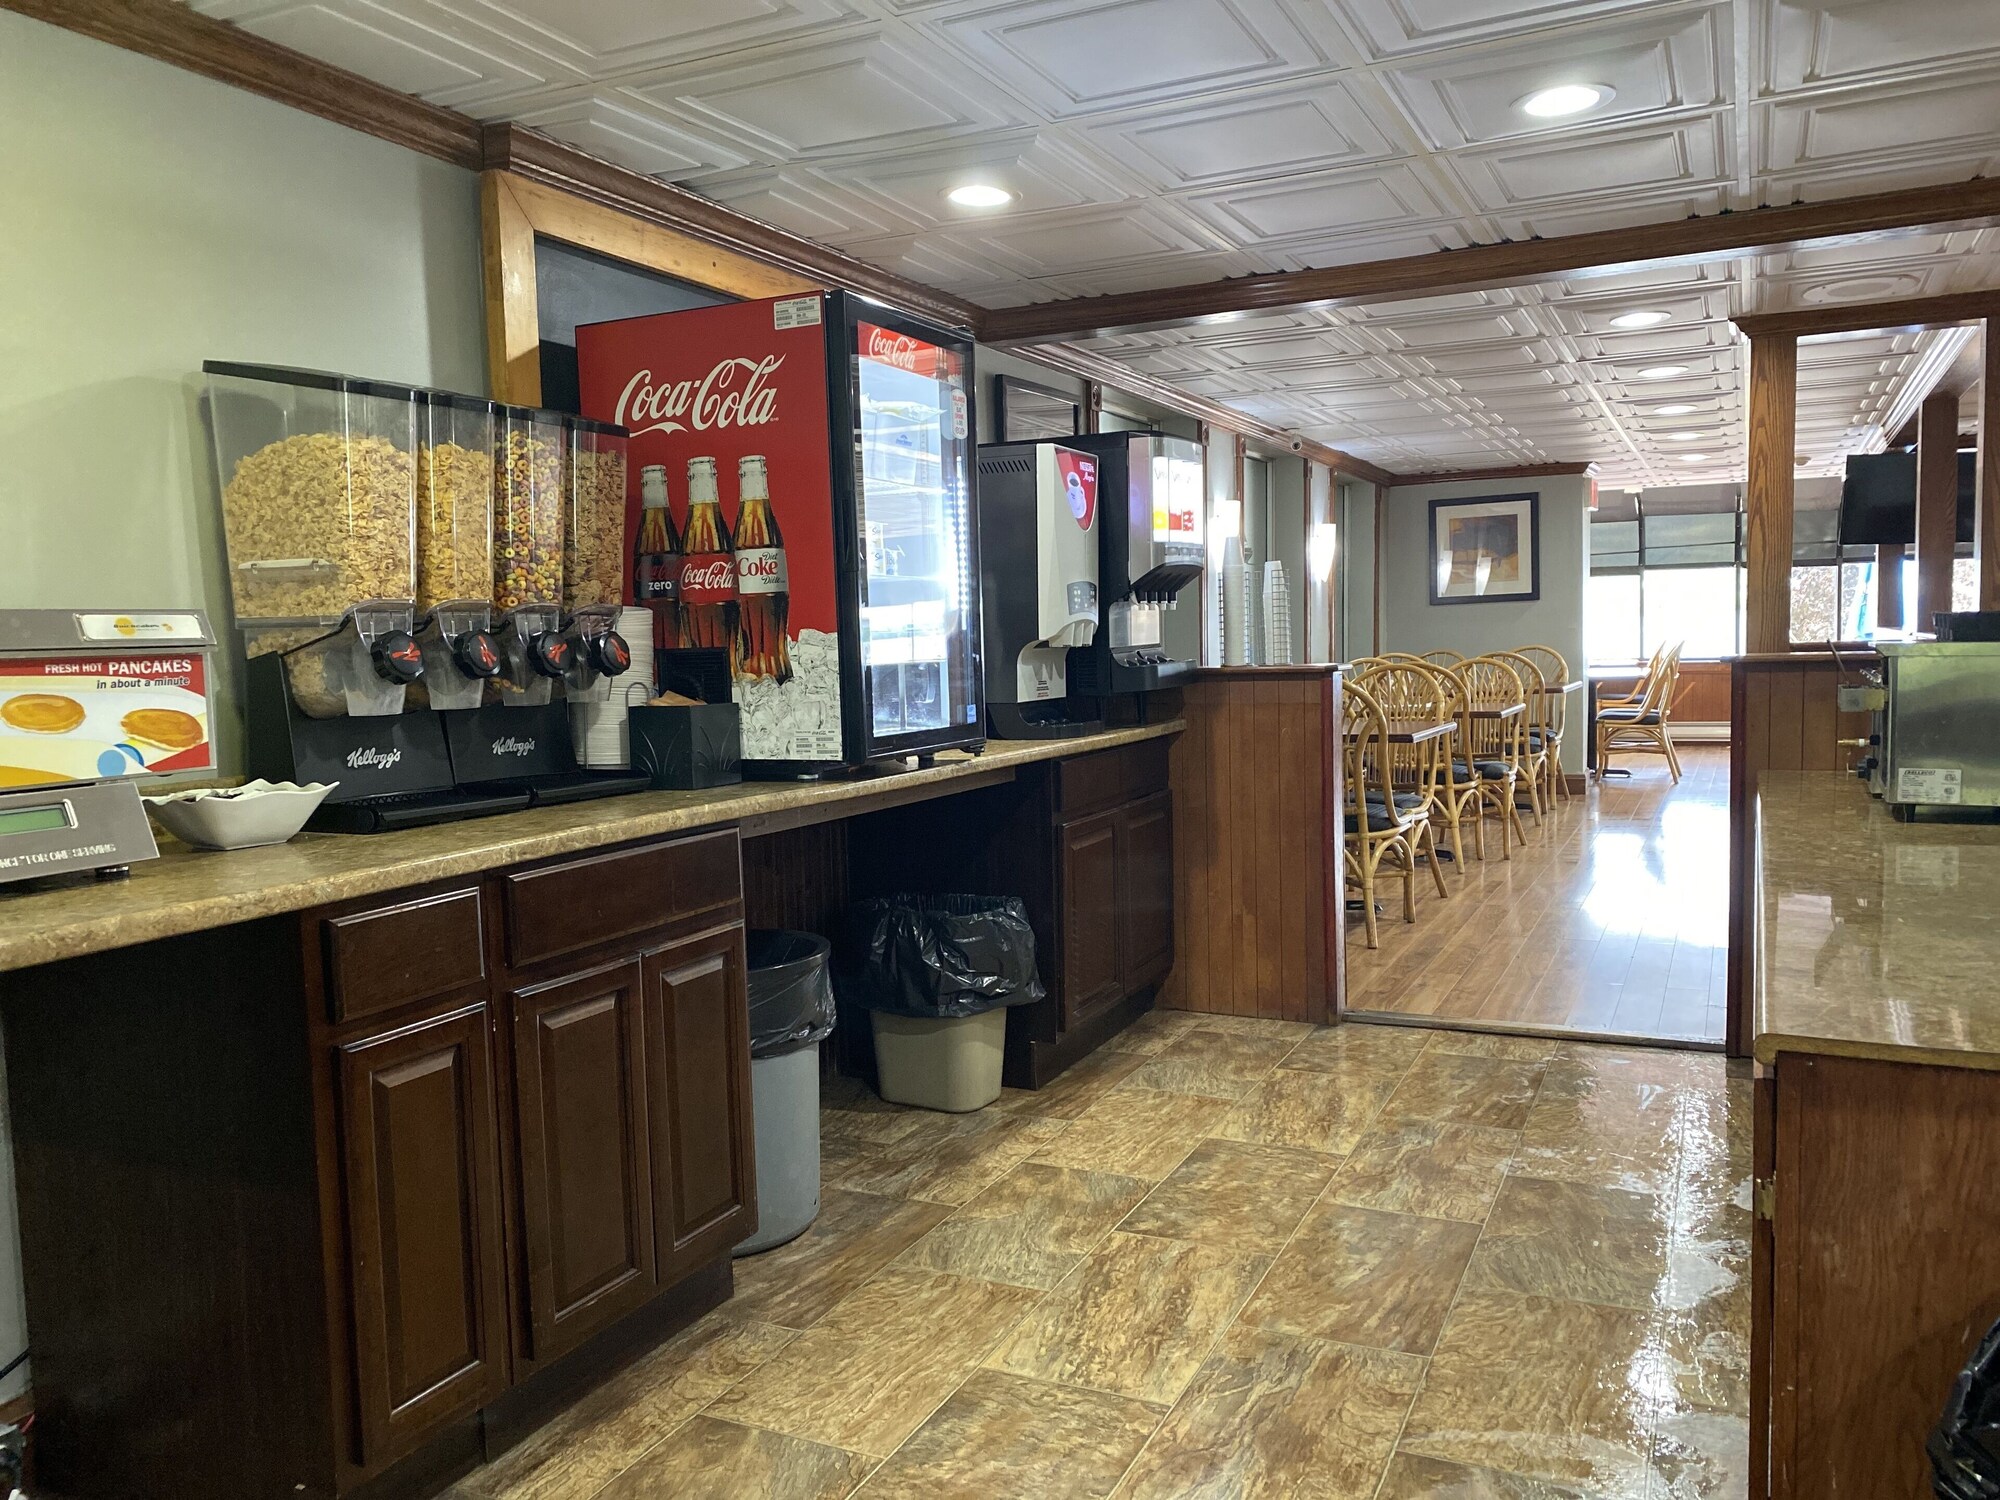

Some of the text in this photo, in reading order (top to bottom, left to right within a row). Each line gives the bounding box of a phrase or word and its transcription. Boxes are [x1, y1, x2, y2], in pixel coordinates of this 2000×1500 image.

[868, 328, 917, 370] Coca-Cola
[615, 352, 787, 438] Coca-Cola
[681, 561, 734, 590] Coca-Cola
[737, 557, 780, 577] Coke
[648, 580, 672, 591] zero
[45, 659, 192, 675] FRESH HOT PANCAKES
[96, 679, 107, 690] in
[110, 678, 141, 688] about
[154, 676, 190, 687] minute
[492, 736, 535, 757] Kellogg's
[347, 747, 401, 770] Kellogg's
